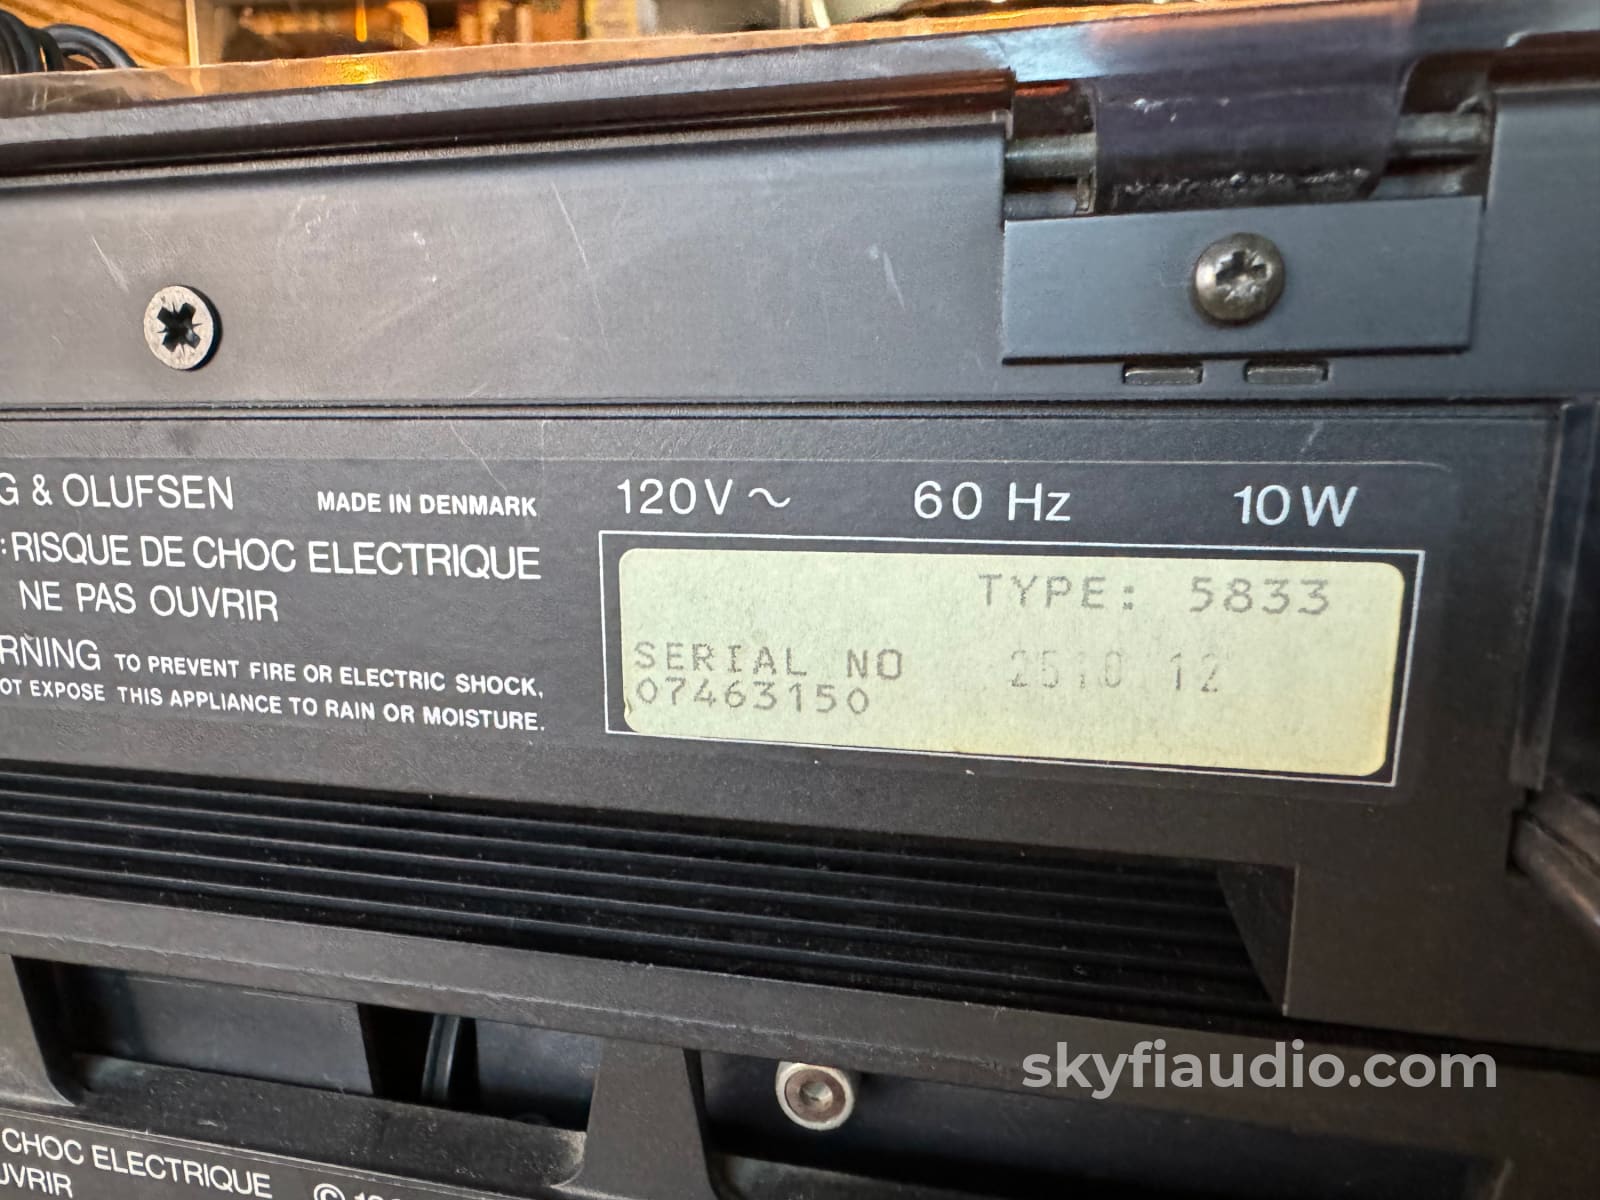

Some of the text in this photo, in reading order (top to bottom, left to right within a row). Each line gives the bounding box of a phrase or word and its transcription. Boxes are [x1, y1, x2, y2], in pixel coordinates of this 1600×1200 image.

[32, 473, 53, 506] &
[62, 473, 234, 510] OLUFSEN
[317, 491, 537, 517] MADE IN DENMARK
[617, 478, 1359, 528] 120V 60 Hz 10W
[140, 535, 186, 567] DE
[192, 536, 297, 573] CHOC
[307, 540, 542, 580] ELECTRIQUE
[19, 579, 279, 622] NE PAS OUVRIR
[978, 573, 1331, 616] TYPE: 5833
[0, 633, 544, 698] RNING TO PREVENT FIRE OR ELECTRIC SHOCK,
[633, 641, 904, 681] SERIAL NO
[1169, 651, 1220, 694] 12
[29, 680, 106, 702] EXPOSE
[117, 687, 163, 707] THIS
[169, 690, 283, 714] APPLIANCE
[288, 697, 319, 717] TO
[325, 699, 376, 721] RAIN
[383, 703, 415, 724] OR
[423, 706, 546, 732] MOISTURE.
[635, 677, 870, 715] 07463150
[1, 1127, 273, 1199] CHOC ELECTRIQUE
